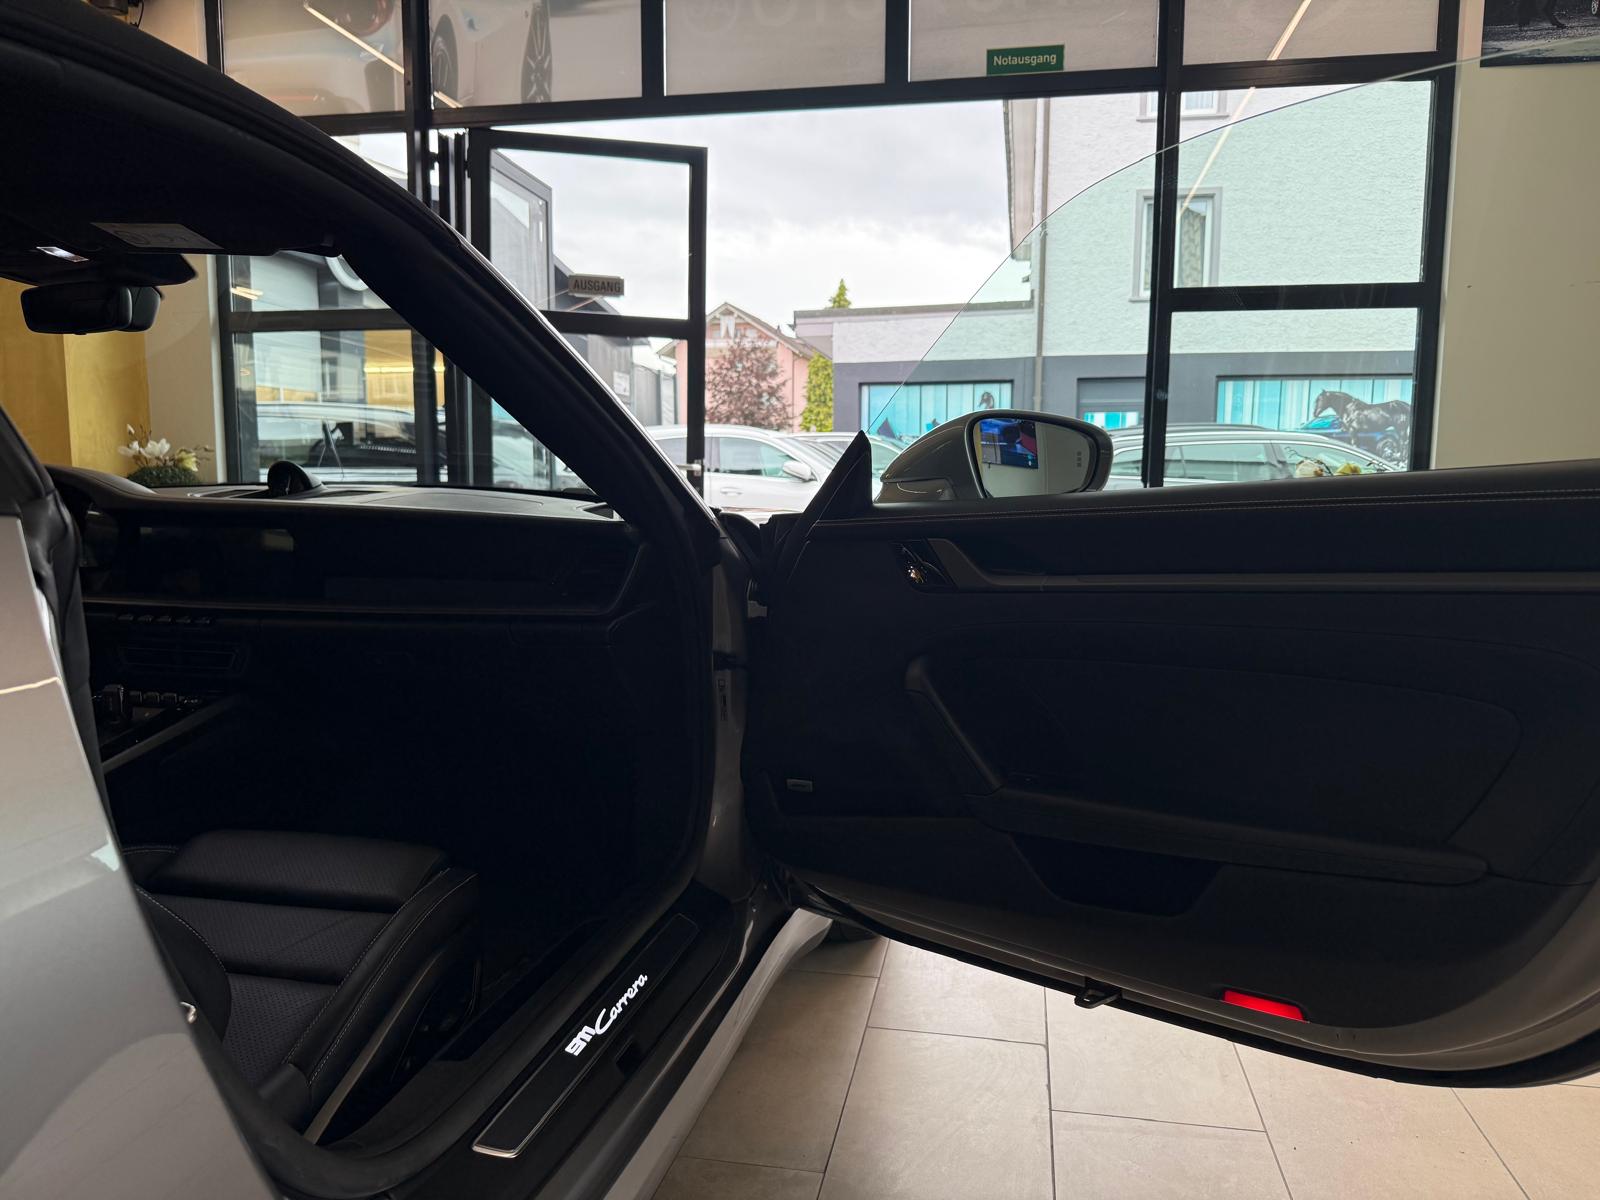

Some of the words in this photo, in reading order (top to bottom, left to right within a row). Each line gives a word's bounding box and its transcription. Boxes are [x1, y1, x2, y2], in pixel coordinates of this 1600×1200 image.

[993, 54, 1057, 66] Notausgang
[573, 280, 622, 293] AUSGANG
[565, 1025, 597, 1057] 911
[594, 974, 648, 1035] Carrera
